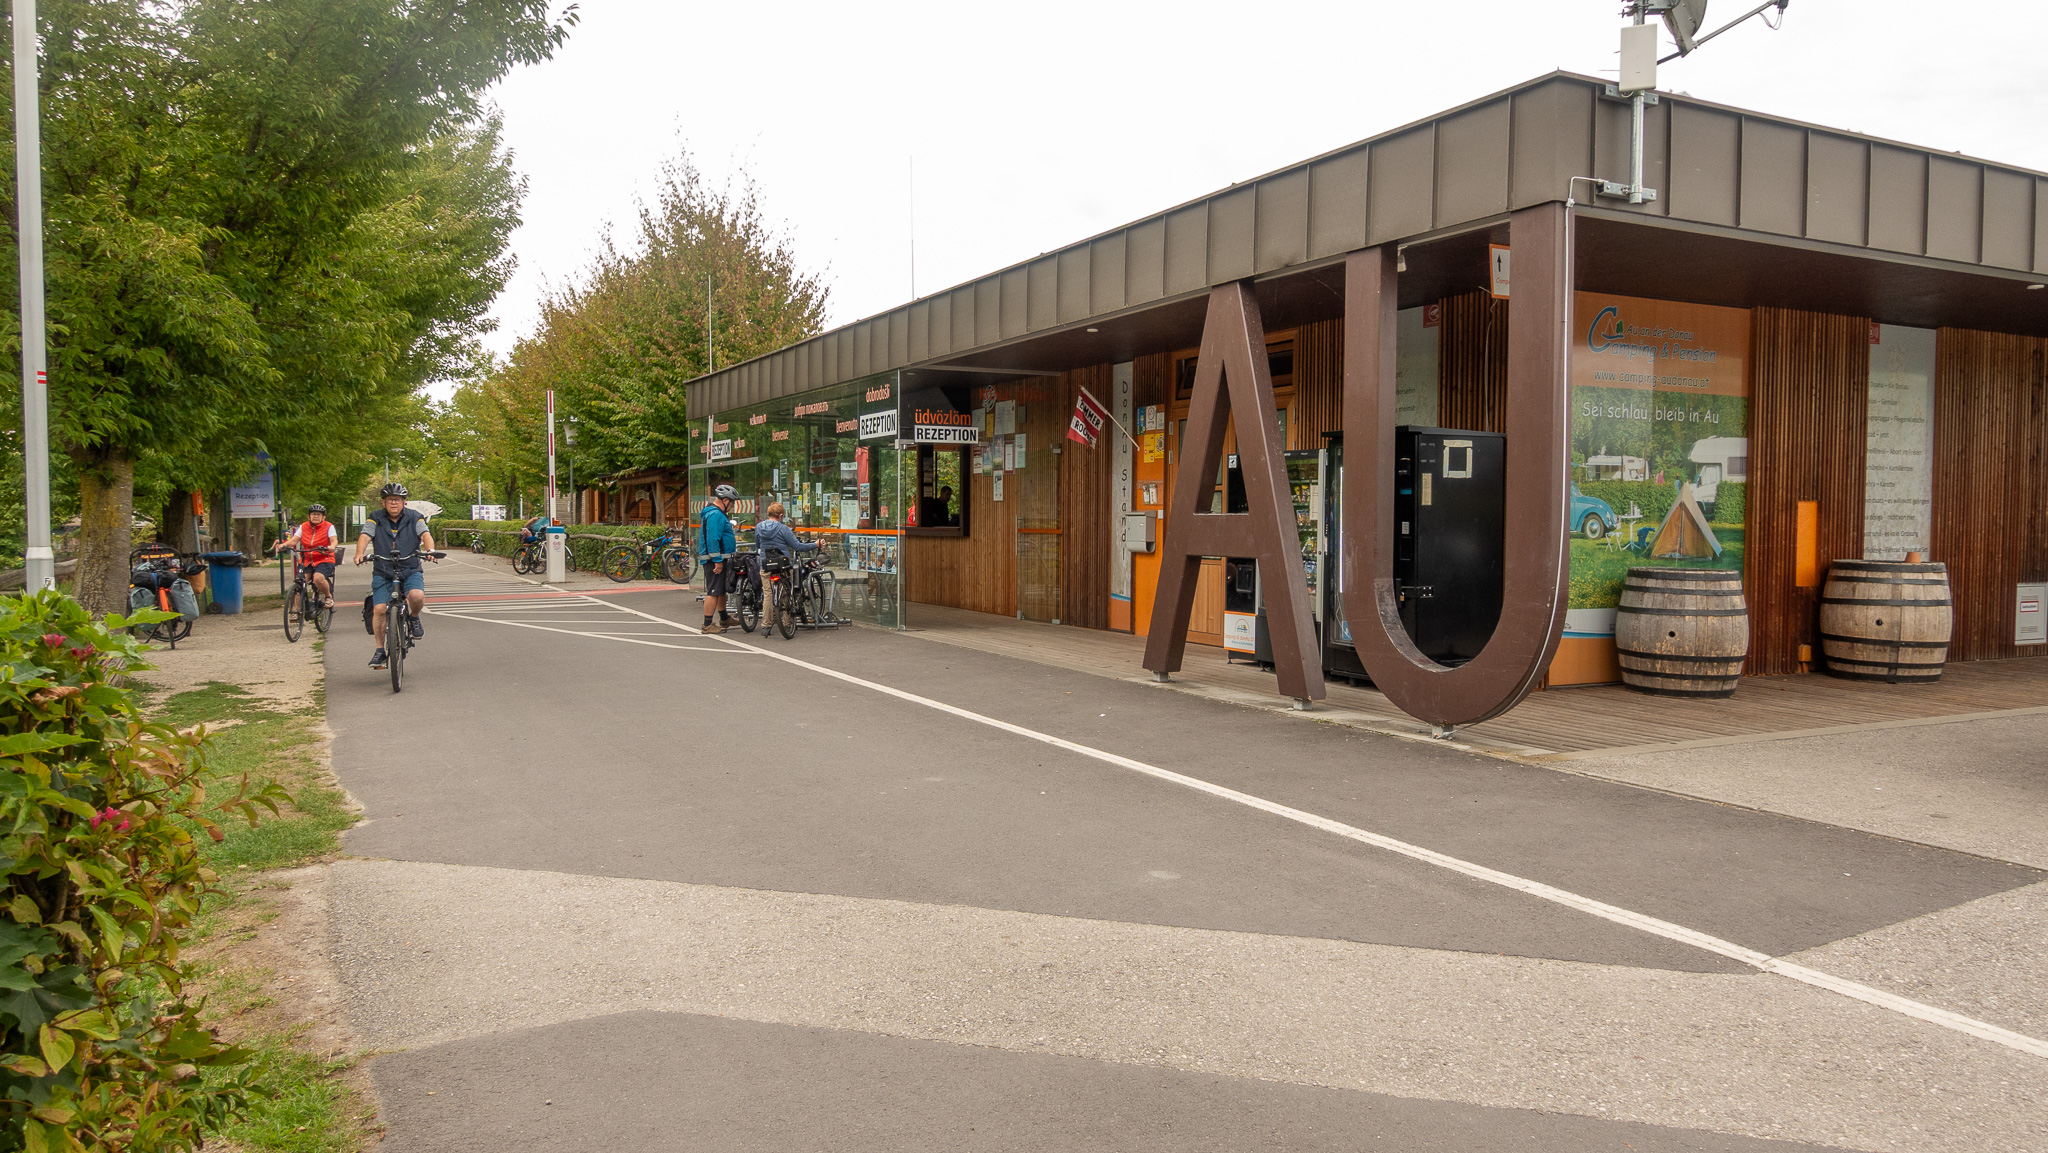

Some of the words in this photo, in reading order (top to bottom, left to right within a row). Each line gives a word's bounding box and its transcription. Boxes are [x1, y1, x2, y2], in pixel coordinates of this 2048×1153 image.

[1587, 306, 1657, 363] Camping
[1659, 343, 1669, 359] &
[1671, 343, 1717, 363] Pension
[1626, 324, 1638, 336] Au
[1640, 327, 1650, 337] an
[1652, 325, 1667, 338] der
[1668, 328, 1694, 341] Donau
[1594, 370, 1710, 388] www.camping-audonau.at
[915, 408, 971, 425] üdvözlöm
[1582, 402, 1602, 417] Sei
[1607, 402, 1652, 423] schlau,
[1655, 406, 1685, 422] bleib
[1689, 408, 1700, 423] in
[1703, 409, 1719, 424] Au
[861, 413, 896, 436] REZEPTION
[916, 428, 977, 441] REZEPTION
